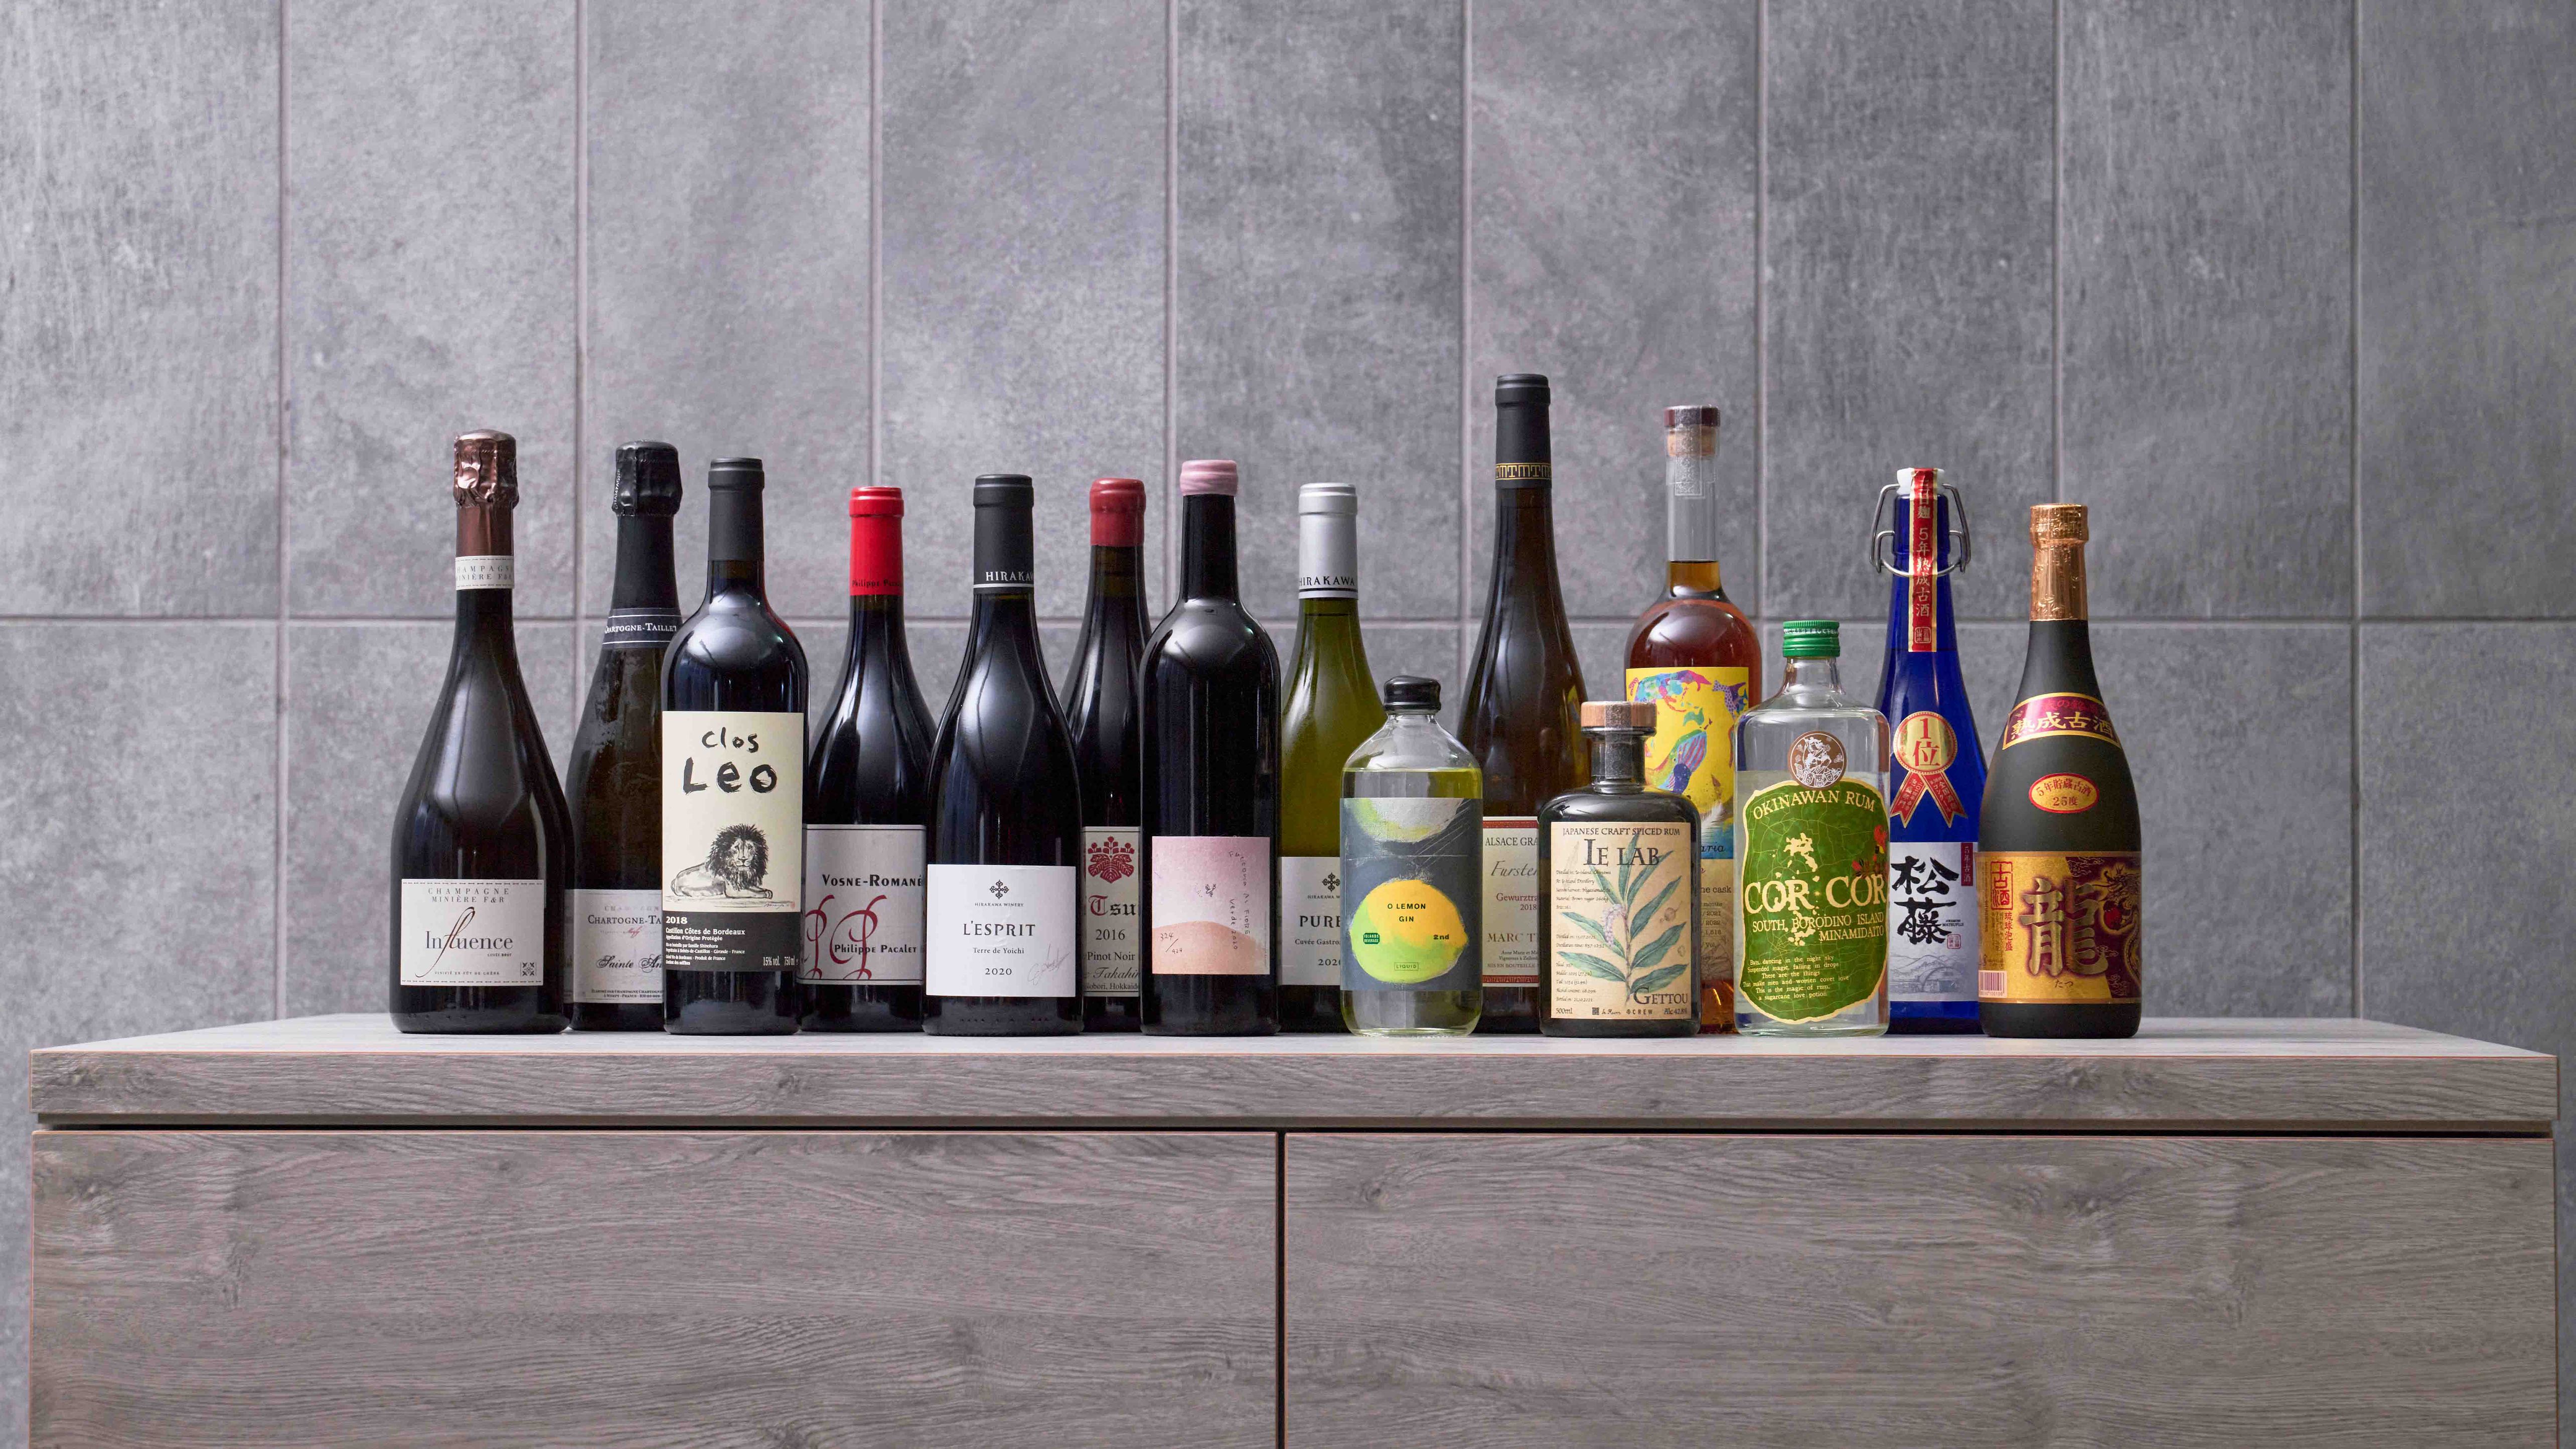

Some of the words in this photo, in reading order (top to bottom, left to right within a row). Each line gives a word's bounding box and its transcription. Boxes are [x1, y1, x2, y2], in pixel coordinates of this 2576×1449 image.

[2011, 711, 2113, 740] 熟成古酒
[1753, 790, 1840, 820] OKINAWAN
[1846, 791, 1875, 812] RUM
[2053, 796, 2078, 806] 25度
[1485, 837, 1518, 846] ALSACE
[1617, 847, 1660, 865] LAB
[1745, 880, 1815, 914] COR
[1826, 874, 1887, 908] COR
[1891, 855, 1960, 945] 松藤
[666, 916, 688, 924] 2018
[963, 920, 1035, 936] L'ESPRIT
[1752, 919, 1786, 933] SOUTH
[1792, 915, 1852, 930] BORODINO
[1857, 912, 1884, 925] ISLAND
[2019, 878, 2108, 976] 龍
[1096, 929, 1125, 940] 2016
[1820, 925, 1884, 942] MINAMIDAITO
[2005, 912, 2013, 951] 琉球泡盛
[596, 955, 634, 968] Sainte
[763, 957, 772, 966] 15%
[1087, 951, 1111, 960] Pinot
[1114, 951, 1135, 960] Noir
[2055, 979, 2073, 988] たつ
[1633, 986, 1688, 1004] GETTOU
